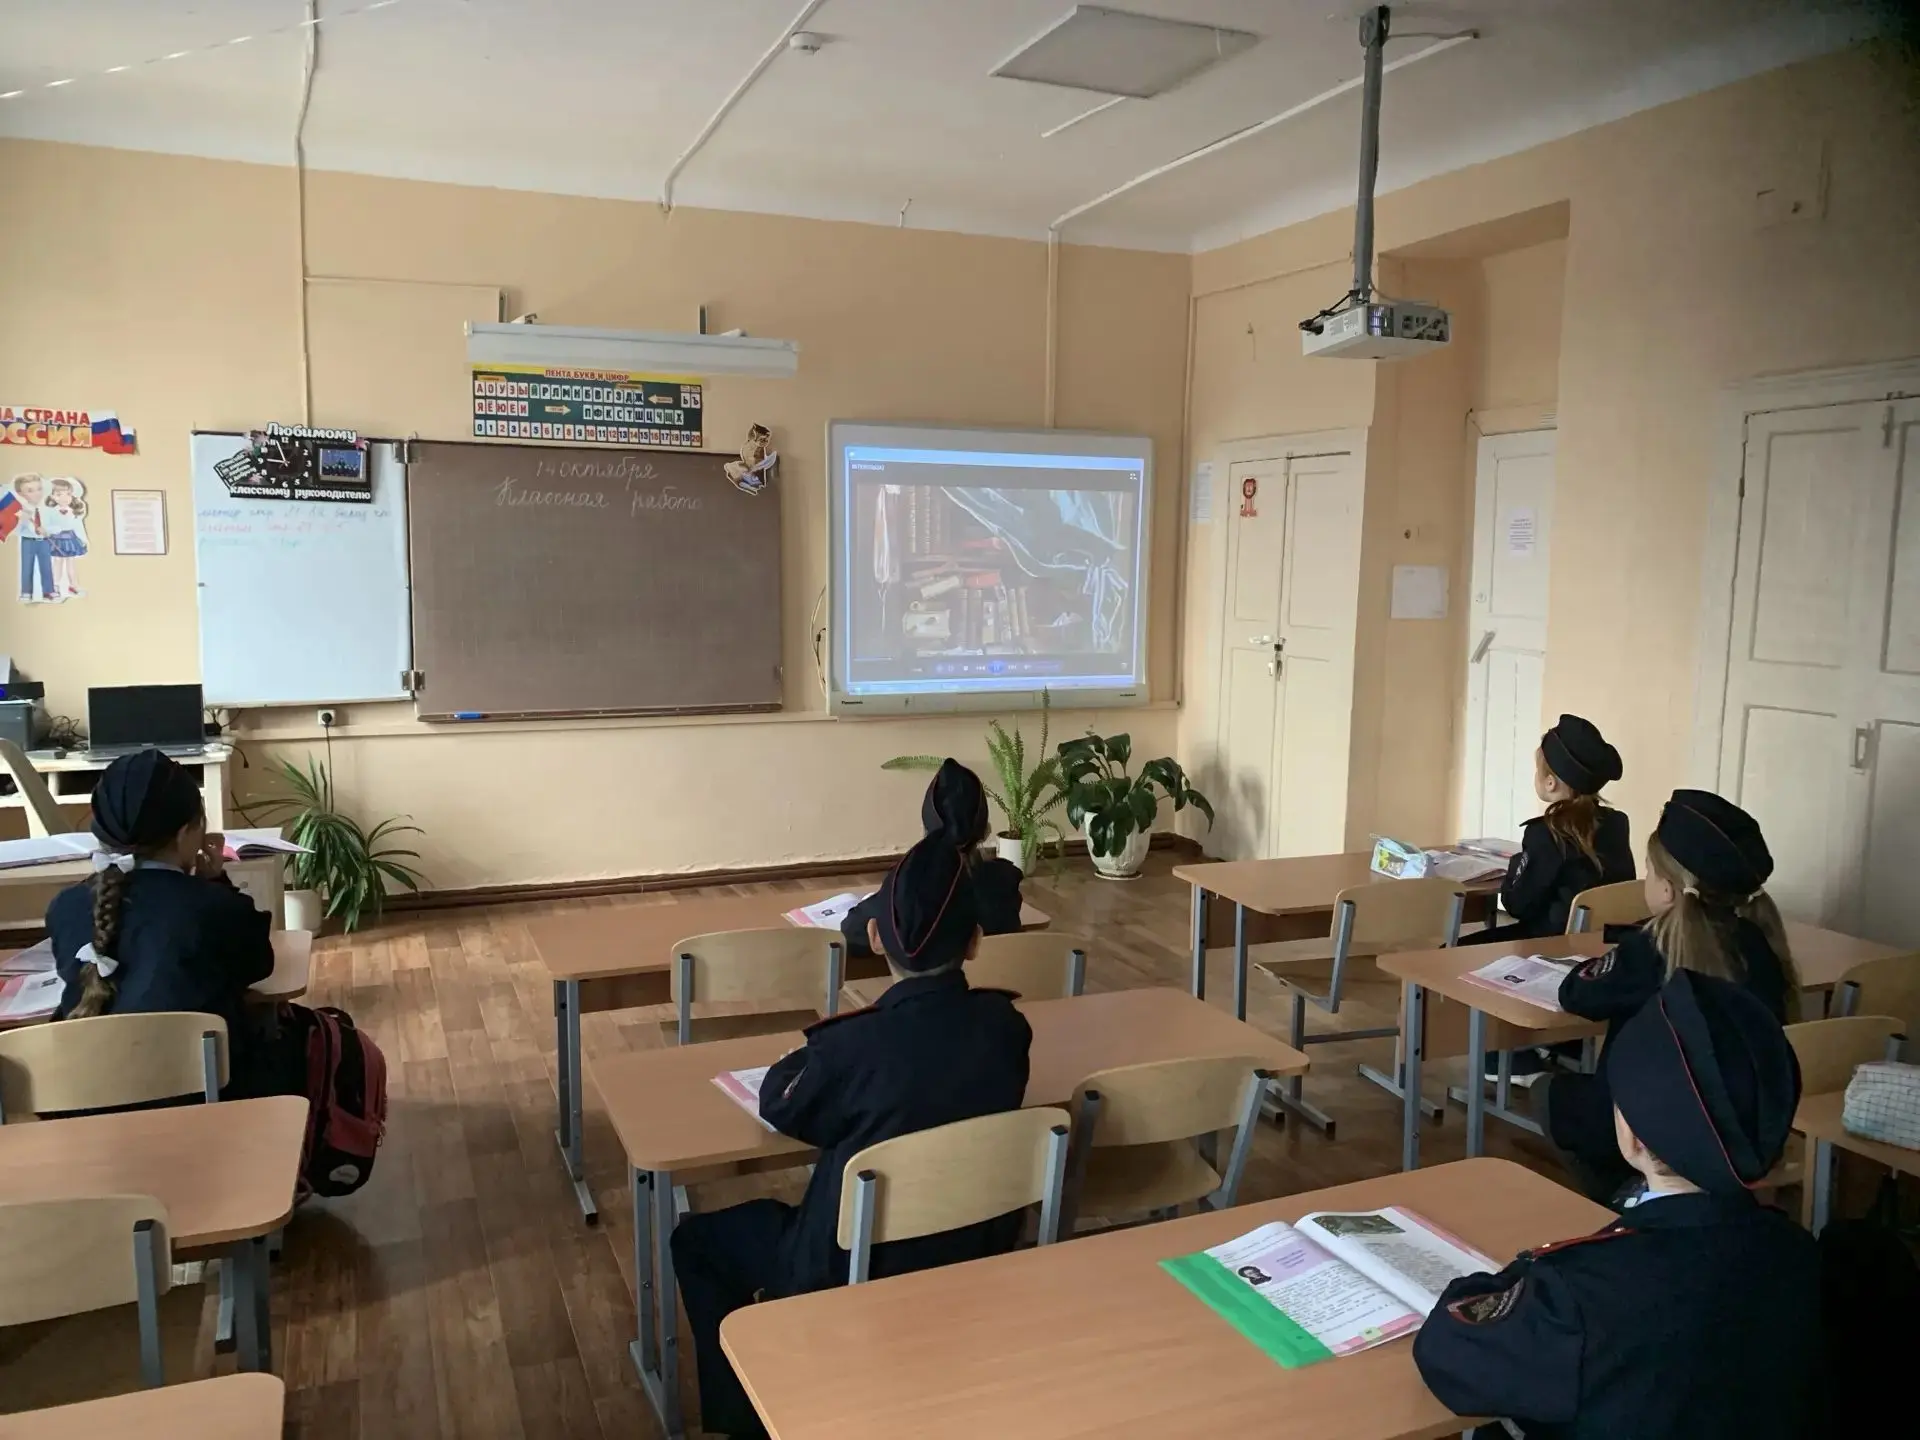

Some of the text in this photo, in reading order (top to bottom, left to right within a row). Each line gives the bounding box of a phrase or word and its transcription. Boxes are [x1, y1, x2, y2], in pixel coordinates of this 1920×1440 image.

[545, 369, 571, 378] ЛЕНТА
[574, 371, 595, 379] БУКВ
[606, 374, 629, 382] ЦИФР
[477, 383, 484, 393] А
[488, 384, 494, 393] О
[499, 384, 506, 394] У
[518, 386, 528, 396] Ы
[542, 386, 549, 396] Р
[552, 386, 559, 397] Л
[563, 387, 571, 398] М
[585, 389, 591, 399] Б
[595, 390, 601, 399] В
[606, 391, 612, 400] Г
[616, 391, 621, 401] З
[626, 392, 632, 402] Д
[635, 393, 643, 402] Ж
[24, 409, 90, 425] СТРАНА
[477, 401, 484, 411] Я
[497, 402, 506, 412] Ю
[510, 403, 516, 413] Е
[520, 404, 527, 414] И
[585, 408, 591, 418] П
[594, 409, 602, 417] Ф
[606, 410, 612, 418] К
[617, 410, 622, 419] С
[626, 411, 632, 419] Т
[635, 411, 644, 420] Ш
[646, 411, 653, 422] Ц
[657, 412, 662, 420] Ч
[676, 413, 682, 422] Х
[267, 422, 357, 442] Любимому
[477, 424, 482, 432] 0
[500, 425, 505, 433] 2
[511, 425, 516, 433] 3
[522, 426, 528, 434] 4
[533, 426, 539, 434] 5
[544, 427, 550, 435] 6
[566, 428, 571, 436] 8
[577, 428, 582, 437] 9
[586, 429, 594, 437] 10
[598, 429, 606, 437] 11
[608, 430, 616, 438] 12
[619, 430, 627, 438] 13
[630, 431, 637, 439] 14
[640, 431, 648, 439] 15
[661, 432, 669, 440] 17
[671, 433, 679, 441] 18
[682, 434, 690, 442] 19
[294, 478, 300, 486] 5
[560, 456, 659, 491] октября
[231, 486, 371, 500] классному руководителю
[495, 476, 610, 508] Классная
